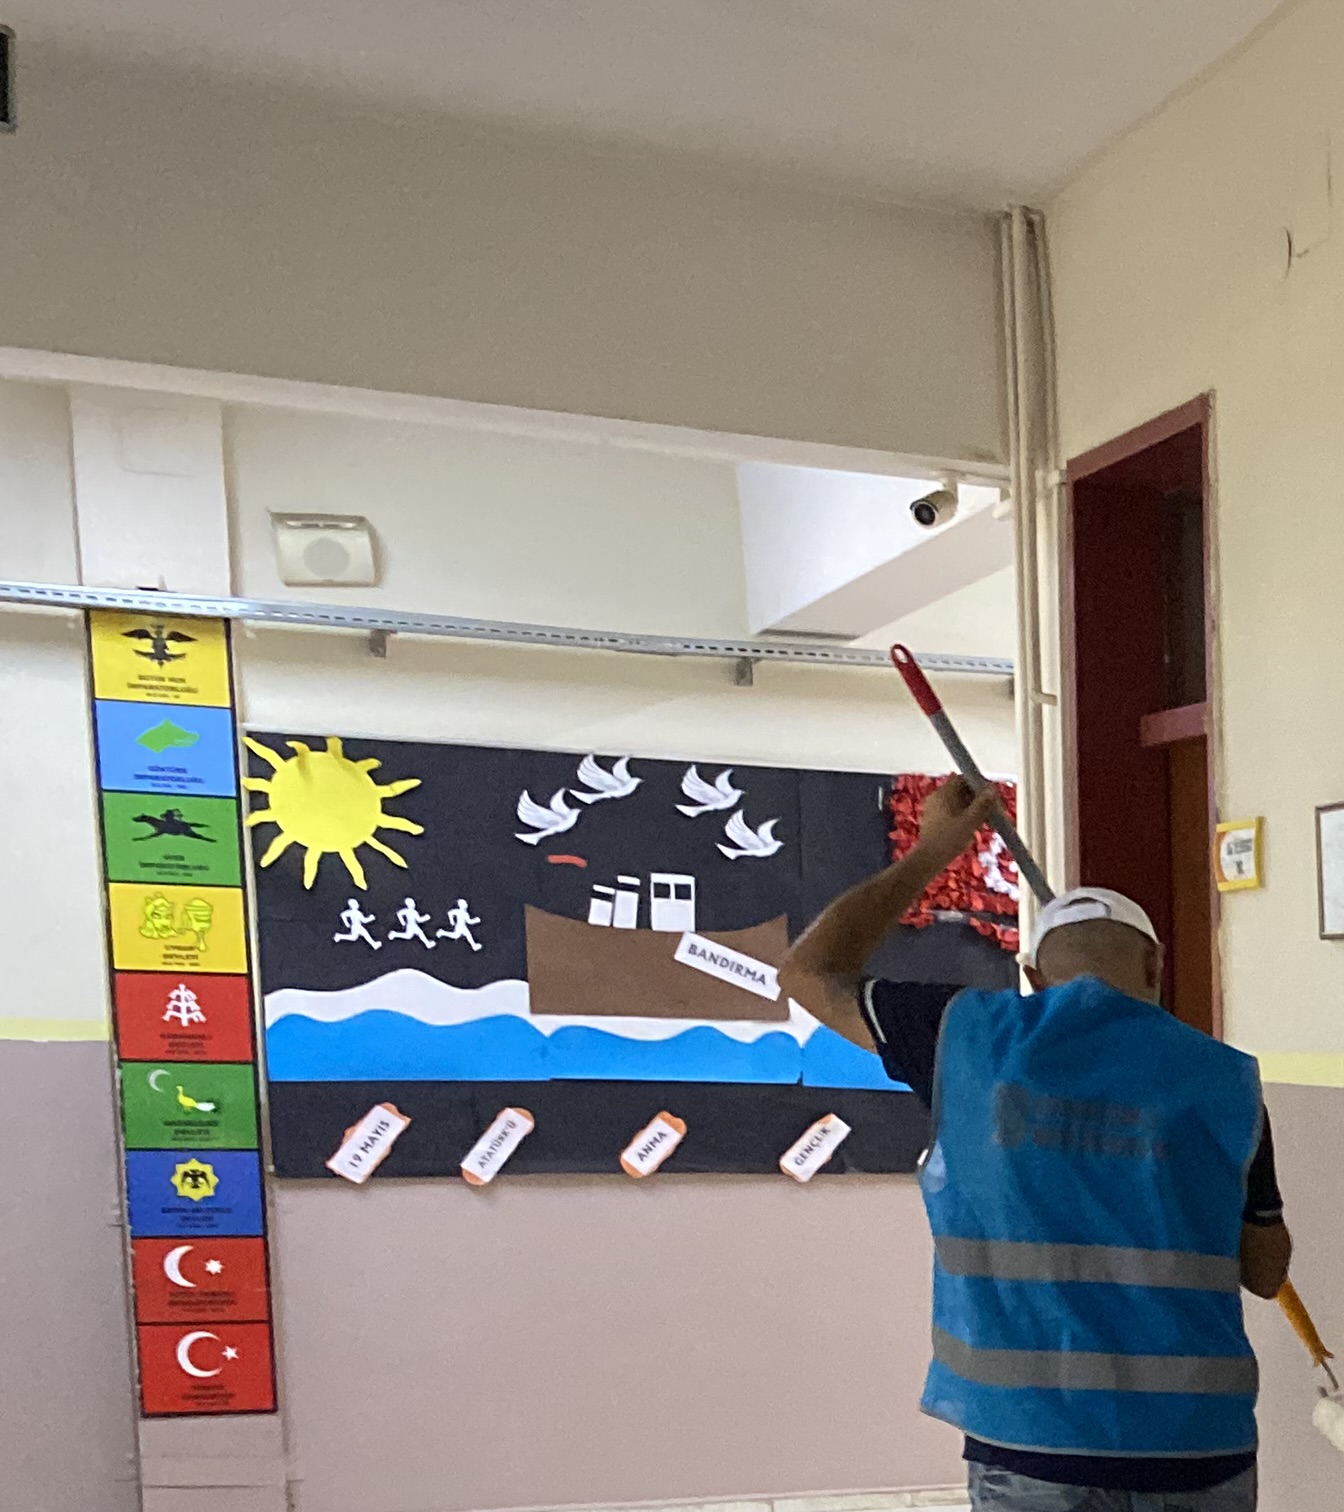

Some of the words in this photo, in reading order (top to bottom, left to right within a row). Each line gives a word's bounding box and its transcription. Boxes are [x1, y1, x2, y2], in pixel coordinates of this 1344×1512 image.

[688, 943, 767, 986] BANDIRMA
[349, 1154, 362, 1169] 19
[360, 1120, 391, 1154] MAYIS
[637, 1131, 668, 1163] ANMA
